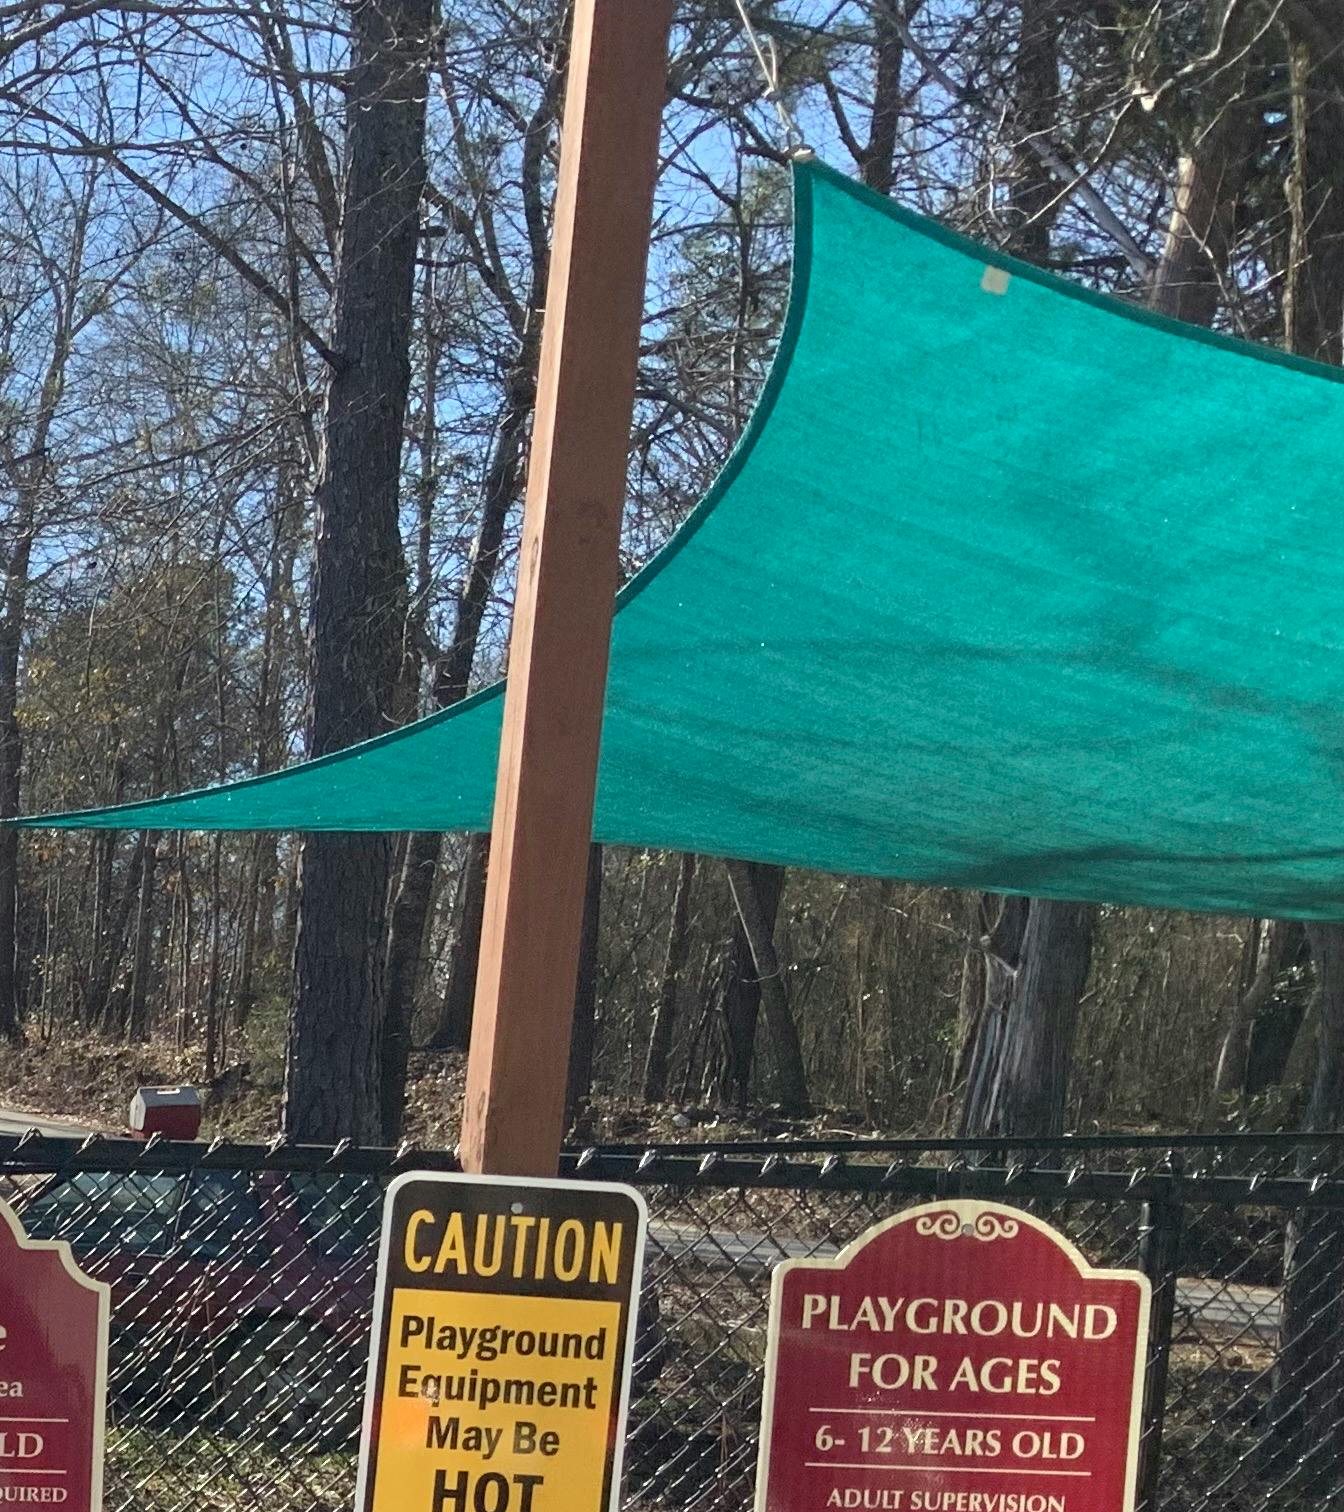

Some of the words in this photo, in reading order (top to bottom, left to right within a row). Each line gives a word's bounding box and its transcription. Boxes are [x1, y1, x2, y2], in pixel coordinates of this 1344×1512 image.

[403, 1208, 622, 1285] CAUTION
[400, 1315, 607, 1361] Playground
[801, 1294, 1117, 1340] PLAYGROUND
[398, 1365, 598, 1410] Equipment
[849, 1353, 938, 1391] FOR
[948, 1357, 1061, 1396] AGES
[426, 1416, 502, 1460] May
[512, 1421, 560, 1457] Be
[903, 1429, 1002, 1458] YEARS
[1012, 1430, 1085, 1460] OLD
[827, 1488, 903, 1510] ADULT
